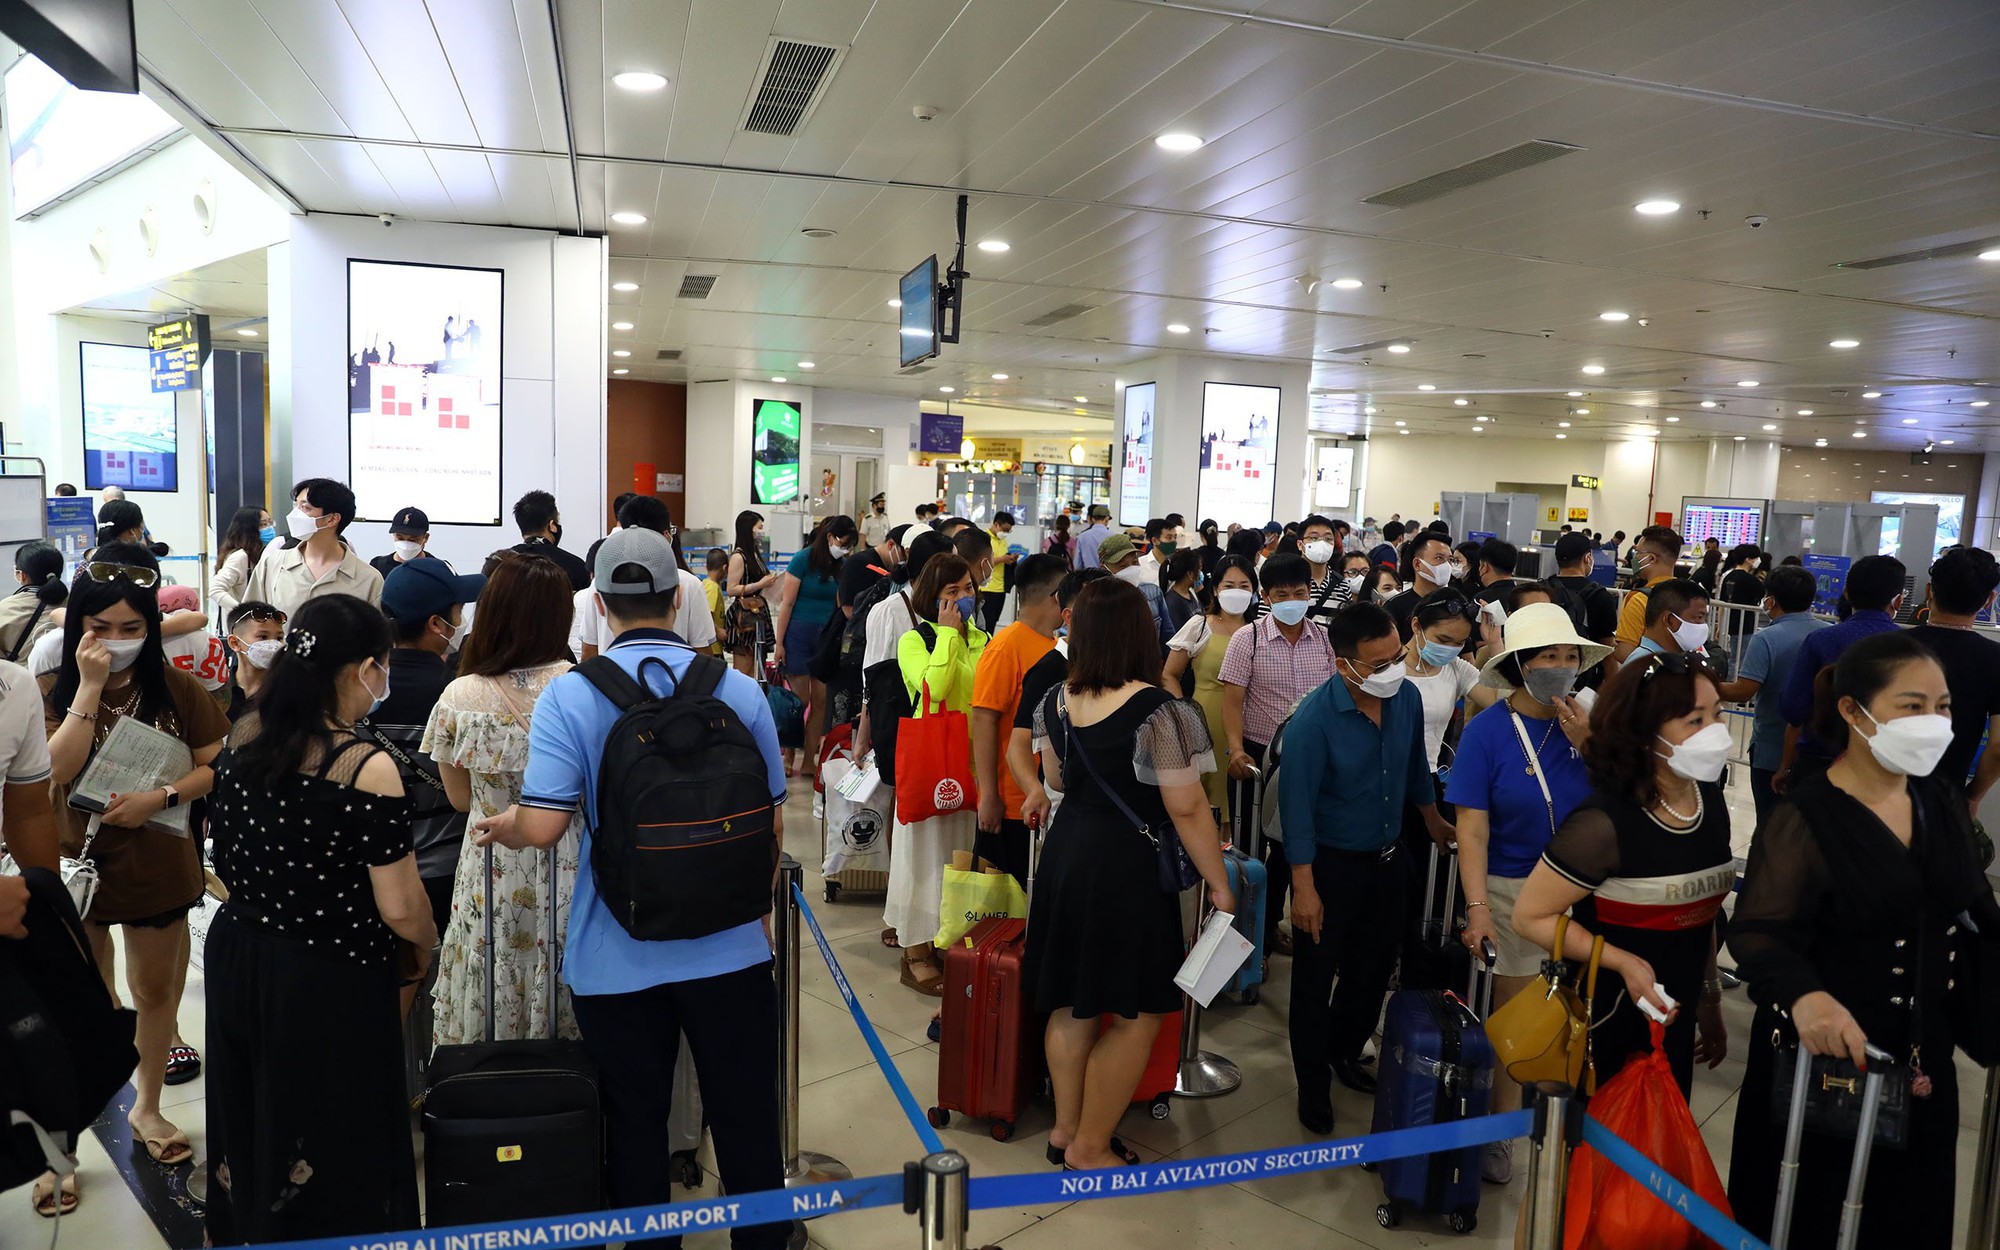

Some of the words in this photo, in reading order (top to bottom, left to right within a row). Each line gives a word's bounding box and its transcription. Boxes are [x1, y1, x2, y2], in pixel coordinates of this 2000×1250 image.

[374, 730, 411, 765] adidas
[1060, 1174, 1103, 1195] NOI
[1110, 1171, 1148, 1191] BAI
[1154, 1157, 1259, 1186] AVIATION
[1264, 1143, 1364, 1171] SECURITY
[444, 1217, 636, 1250] INTERNATIONAL
[643, 1203, 740, 1233] AIRPORT
